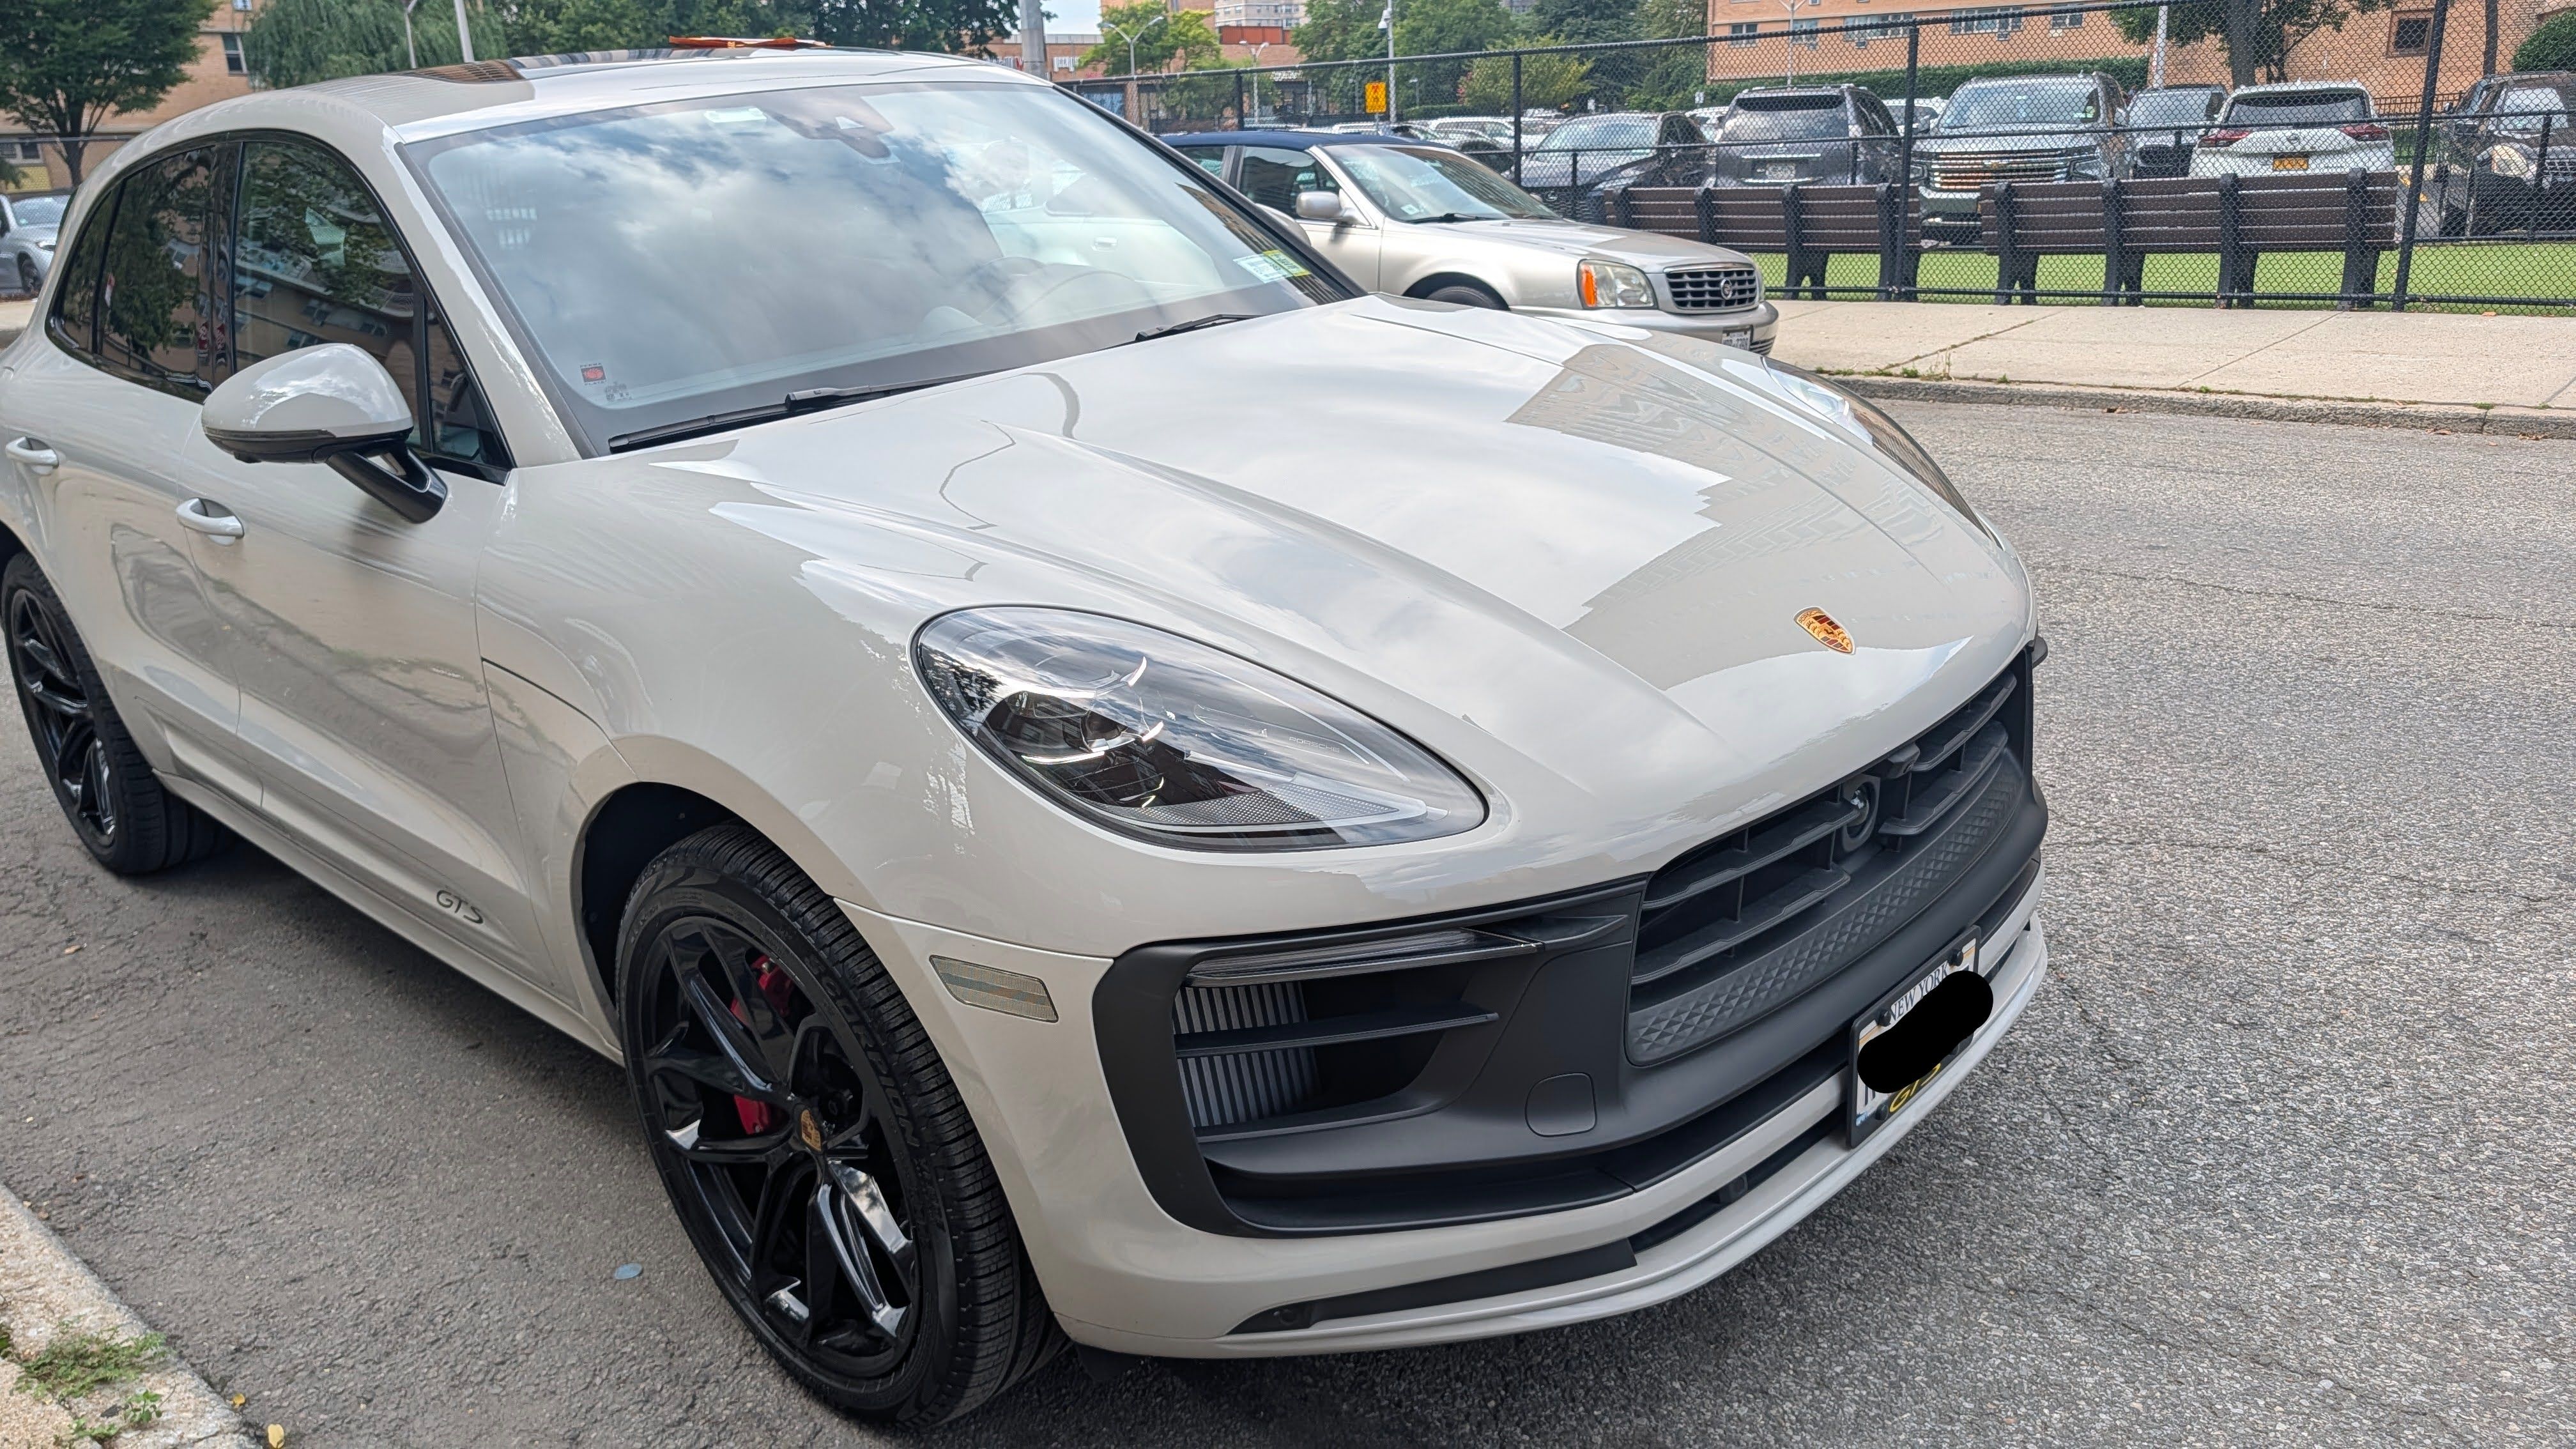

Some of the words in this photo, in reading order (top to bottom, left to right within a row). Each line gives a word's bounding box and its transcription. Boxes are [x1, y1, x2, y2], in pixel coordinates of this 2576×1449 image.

[1289, 736, 1340, 753] PORSCHE
[436, 889, 484, 924] GTS
[1889, 986, 1917, 1022] NEW
[1917, 962, 1949, 998] YORK
[805, 954, 921, 1148] SCORPION
